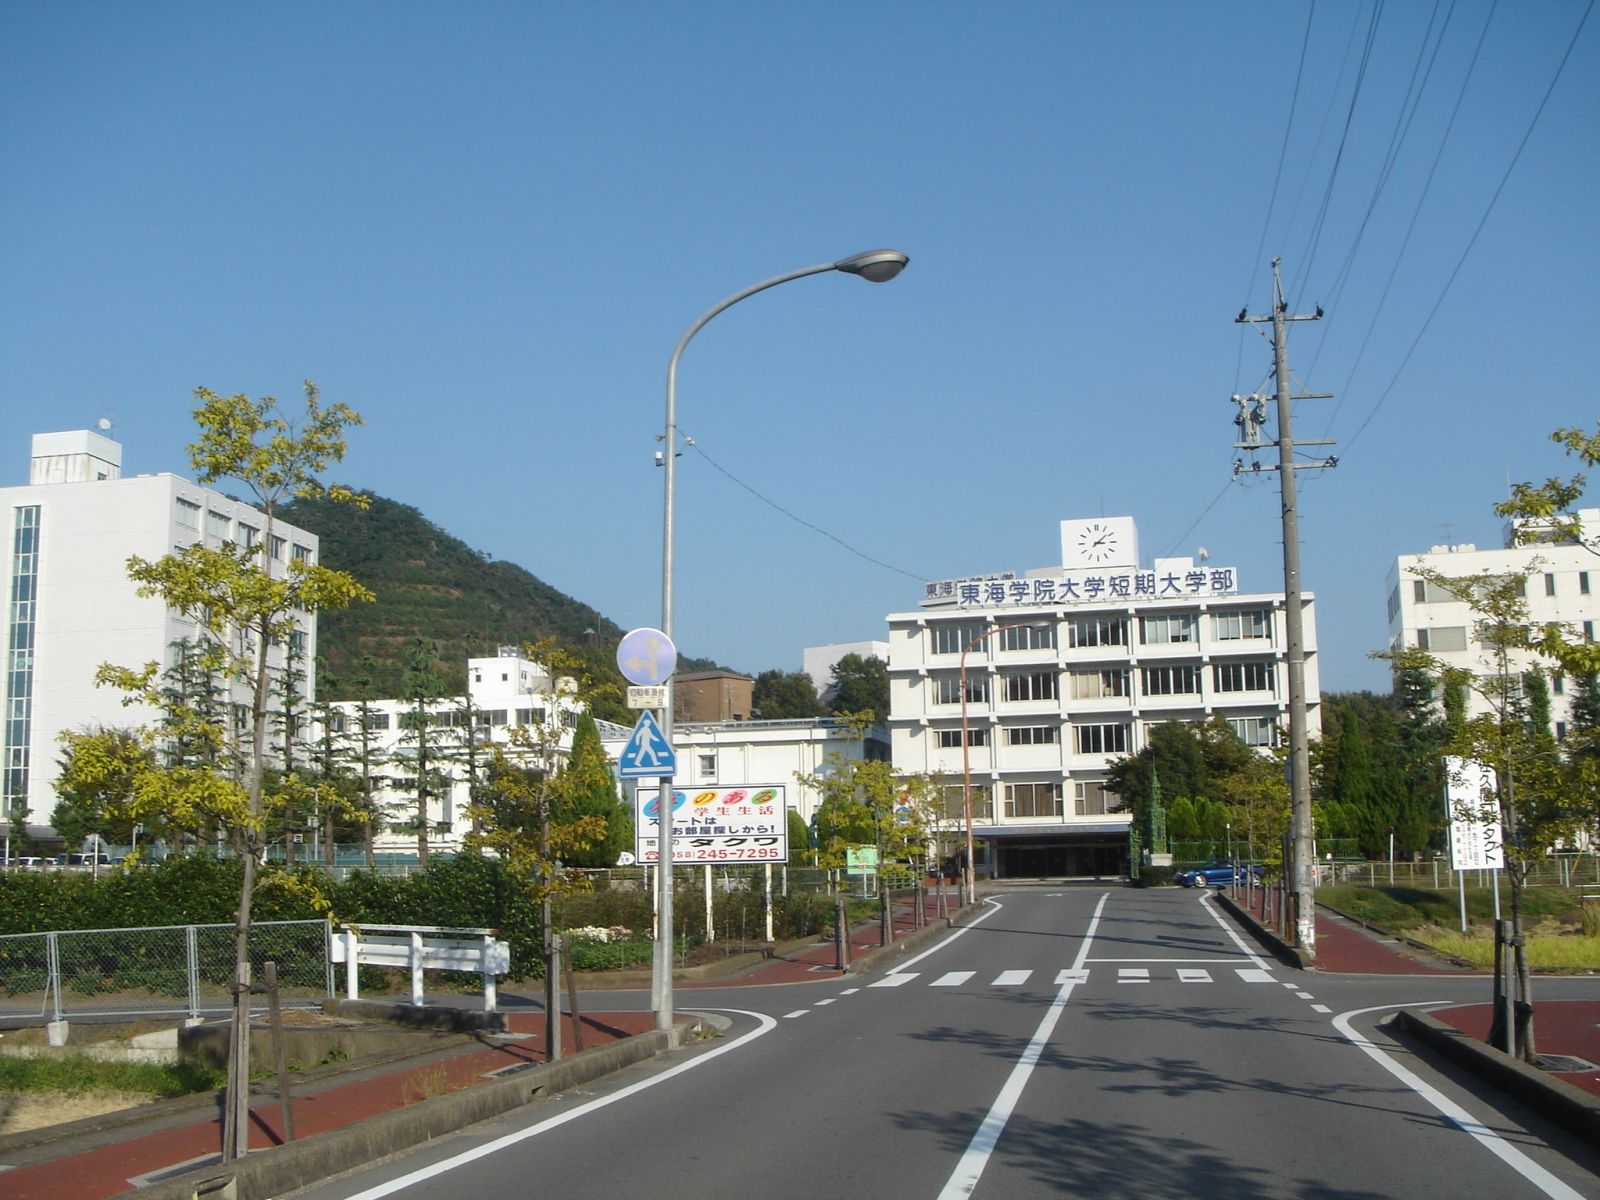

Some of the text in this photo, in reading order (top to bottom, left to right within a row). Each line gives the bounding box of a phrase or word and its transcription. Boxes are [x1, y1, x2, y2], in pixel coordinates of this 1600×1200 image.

[960, 568, 1234, 605] 東海学院大学短期大学部
[694, 805, 775, 816] 学生生活
[648, 817, 717, 826] スートは
[646, 837, 779, 847] 地の タクワ
[698, 848, 779, 859] 245-7295
